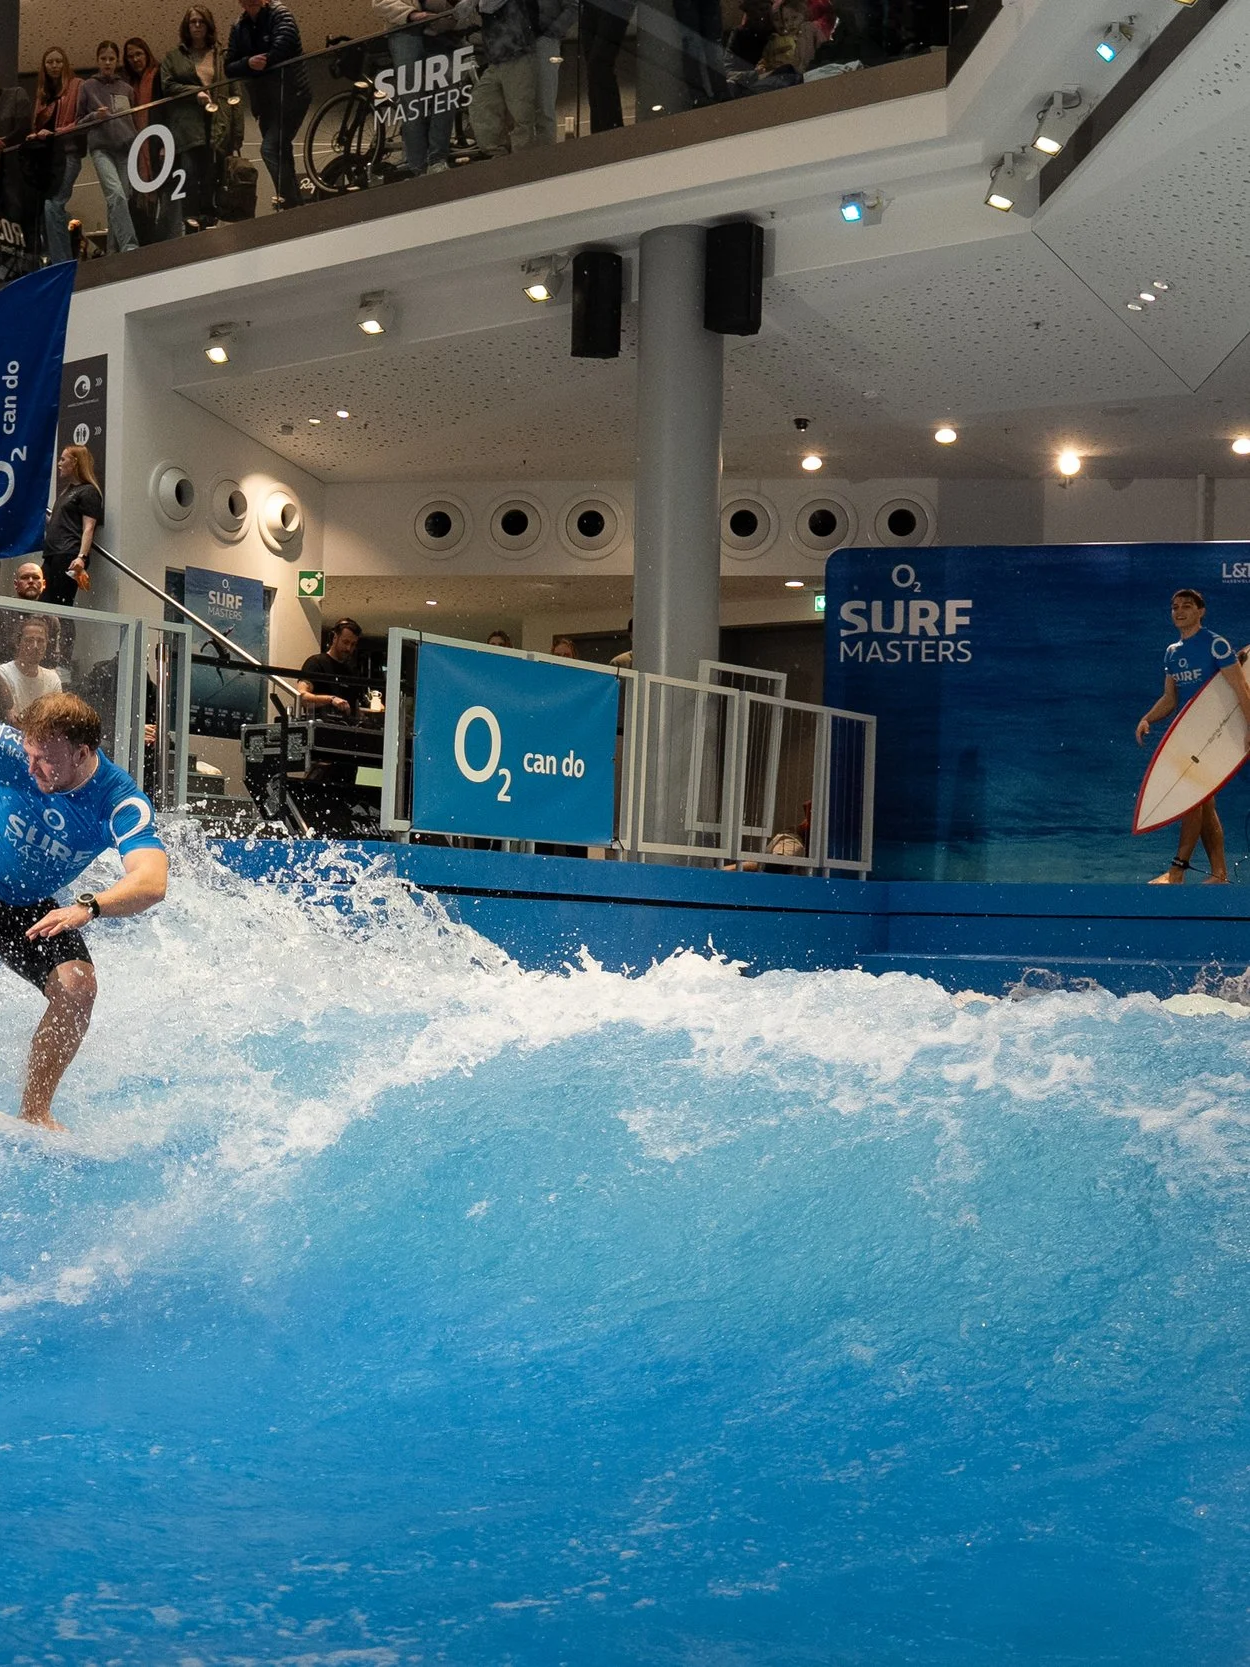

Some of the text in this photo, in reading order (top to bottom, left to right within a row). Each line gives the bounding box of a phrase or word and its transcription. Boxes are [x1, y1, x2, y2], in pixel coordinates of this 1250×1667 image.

[374, 45, 474, 106] SURF
[373, 84, 473, 132] MASTERS
[127, 124, 187, 201] O2
[2, 360, 20, 389] do
[3, 395, 17, 435] can
[891, 564, 922, 593] O2
[207, 606, 243, 621] MASTERS
[208, 590, 243, 610] SURF
[840, 599, 973, 637] SURF
[839, 640, 972, 663] MASTERS
[454, 705, 585, 803] O2 can do
[8, 813, 94, 863] SURF
[43, 808, 69, 842] O2
